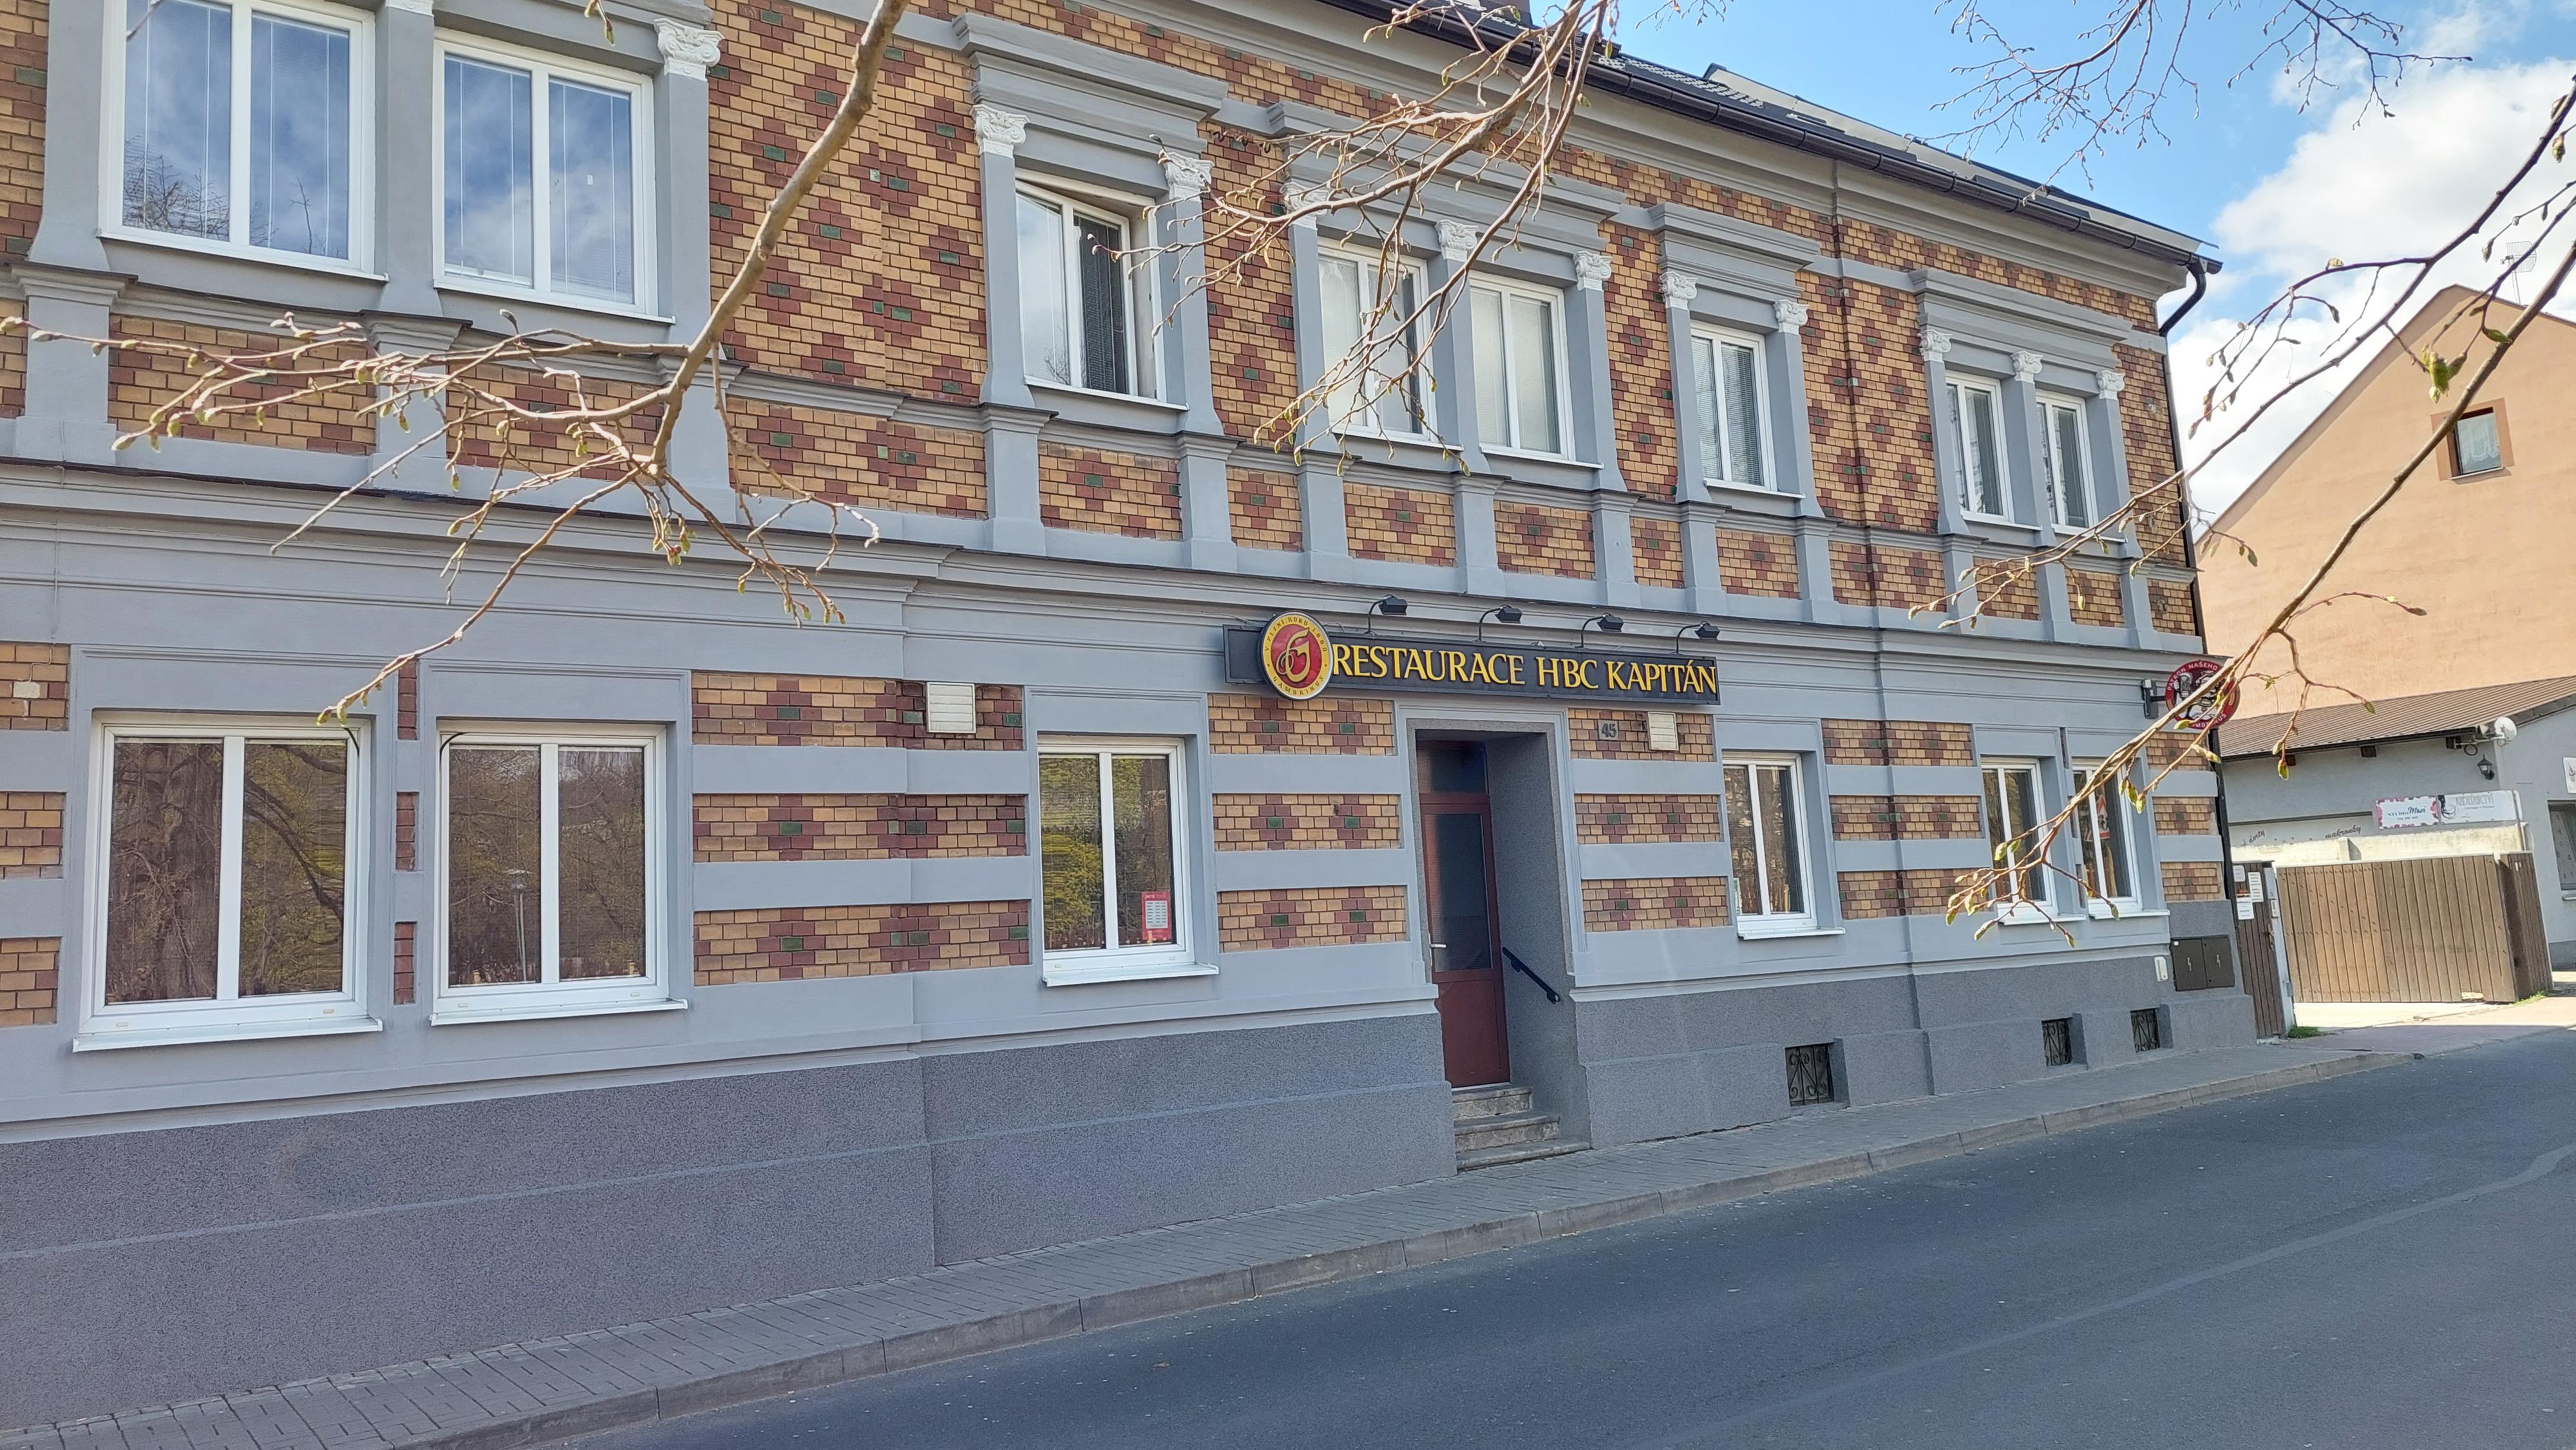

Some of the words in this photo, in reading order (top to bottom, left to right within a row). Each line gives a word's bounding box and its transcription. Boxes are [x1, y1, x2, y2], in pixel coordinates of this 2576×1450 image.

[1287, 617, 1309, 626] ROKU
[1332, 643, 1526, 685] RESTAURACE
[1535, 656, 1598, 690] HBC
[1604, 659, 1716, 694] KAPITÁN
[2167, 667, 2186, 691] PATRON
[2188, 661, 2219, 670] NAŠEHO
[1273, 675, 1324, 695] GAMBRINUS
[1602, 723, 1617, 738] 45
